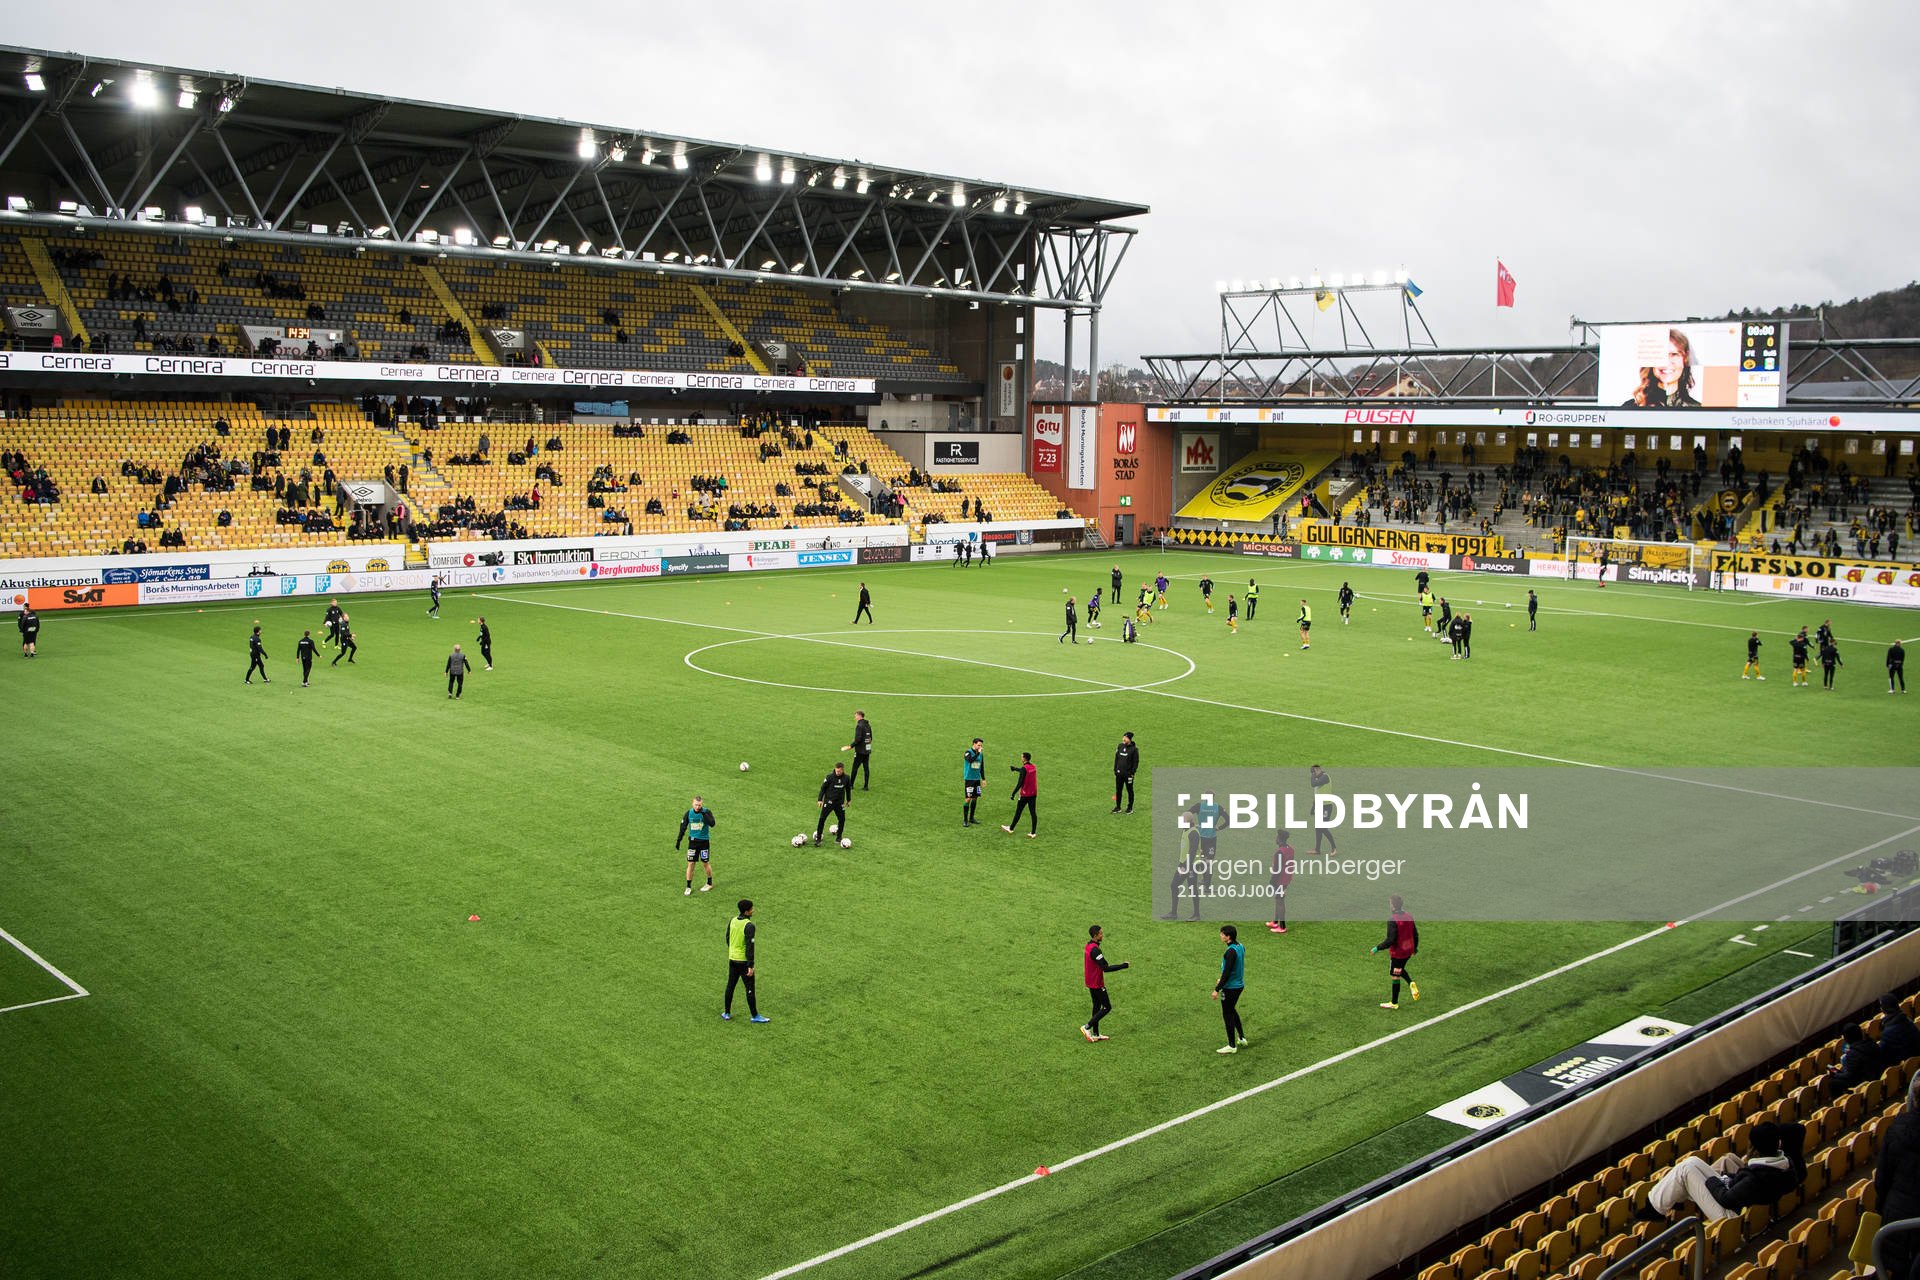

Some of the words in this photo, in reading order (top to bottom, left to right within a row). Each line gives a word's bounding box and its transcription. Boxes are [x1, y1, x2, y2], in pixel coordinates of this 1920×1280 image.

[42, 355, 112, 370] Cernera
[146, 358, 224, 374] Cernera
[252, 362, 314, 376] Cernera
[380, 366, 423, 378] Cernera
[438, 367, 500, 382] Cernera
[512, 370, 555, 382] Cernera
[563, 370, 623, 386] Cernera
[632, 374, 675, 386] Cernera
[686, 374, 744, 389] Cernera
[754, 378, 797, 390] Cernera
[809, 379, 857, 392] Cernera
[1169, 410, 1181, 422] put
[1219, 410, 1231, 422] put
[1272, 411, 1284, 422] put
[1344, 410, 1416, 424] PULSEN
[1539, 414, 1607, 423] RO-GRUPPEN
[1731, 415, 1785, 427] Sparbanken
[1786, 416, 1828, 427] Sjuhärad
[1036, 419, 1061, 435] City
[1186, 435, 1214, 465] MAX
[1039, 453, 1057, 463] 7-23
[1113, 457, 1139, 469] BORÅS
[1115, 470, 1135, 480] STAD
[754, 540, 791, 551] PEAB
[1307, 525, 1420, 552] GULIGANERNA
[1451, 537, 1488, 556] 1991
[433, 556, 461, 566] COMFORT
[600, 550, 649, 560] FRONT
[800, 552, 850, 563] JENSEN
[512, 570, 551, 579] Sparbanken
[599, 563, 660, 577] Bergkvarabuss
[0, 577, 99, 588] Akustikgruppen
[455, 569, 490, 585] travel
[146, 585, 170, 594] Borås
[171, 582, 240, 593] MurningsArbeten
[1815, 585, 1850, 598] IBAB
[64, 588, 105, 604] SIXT
[1549, 1056, 1624, 1091] UNIBET
